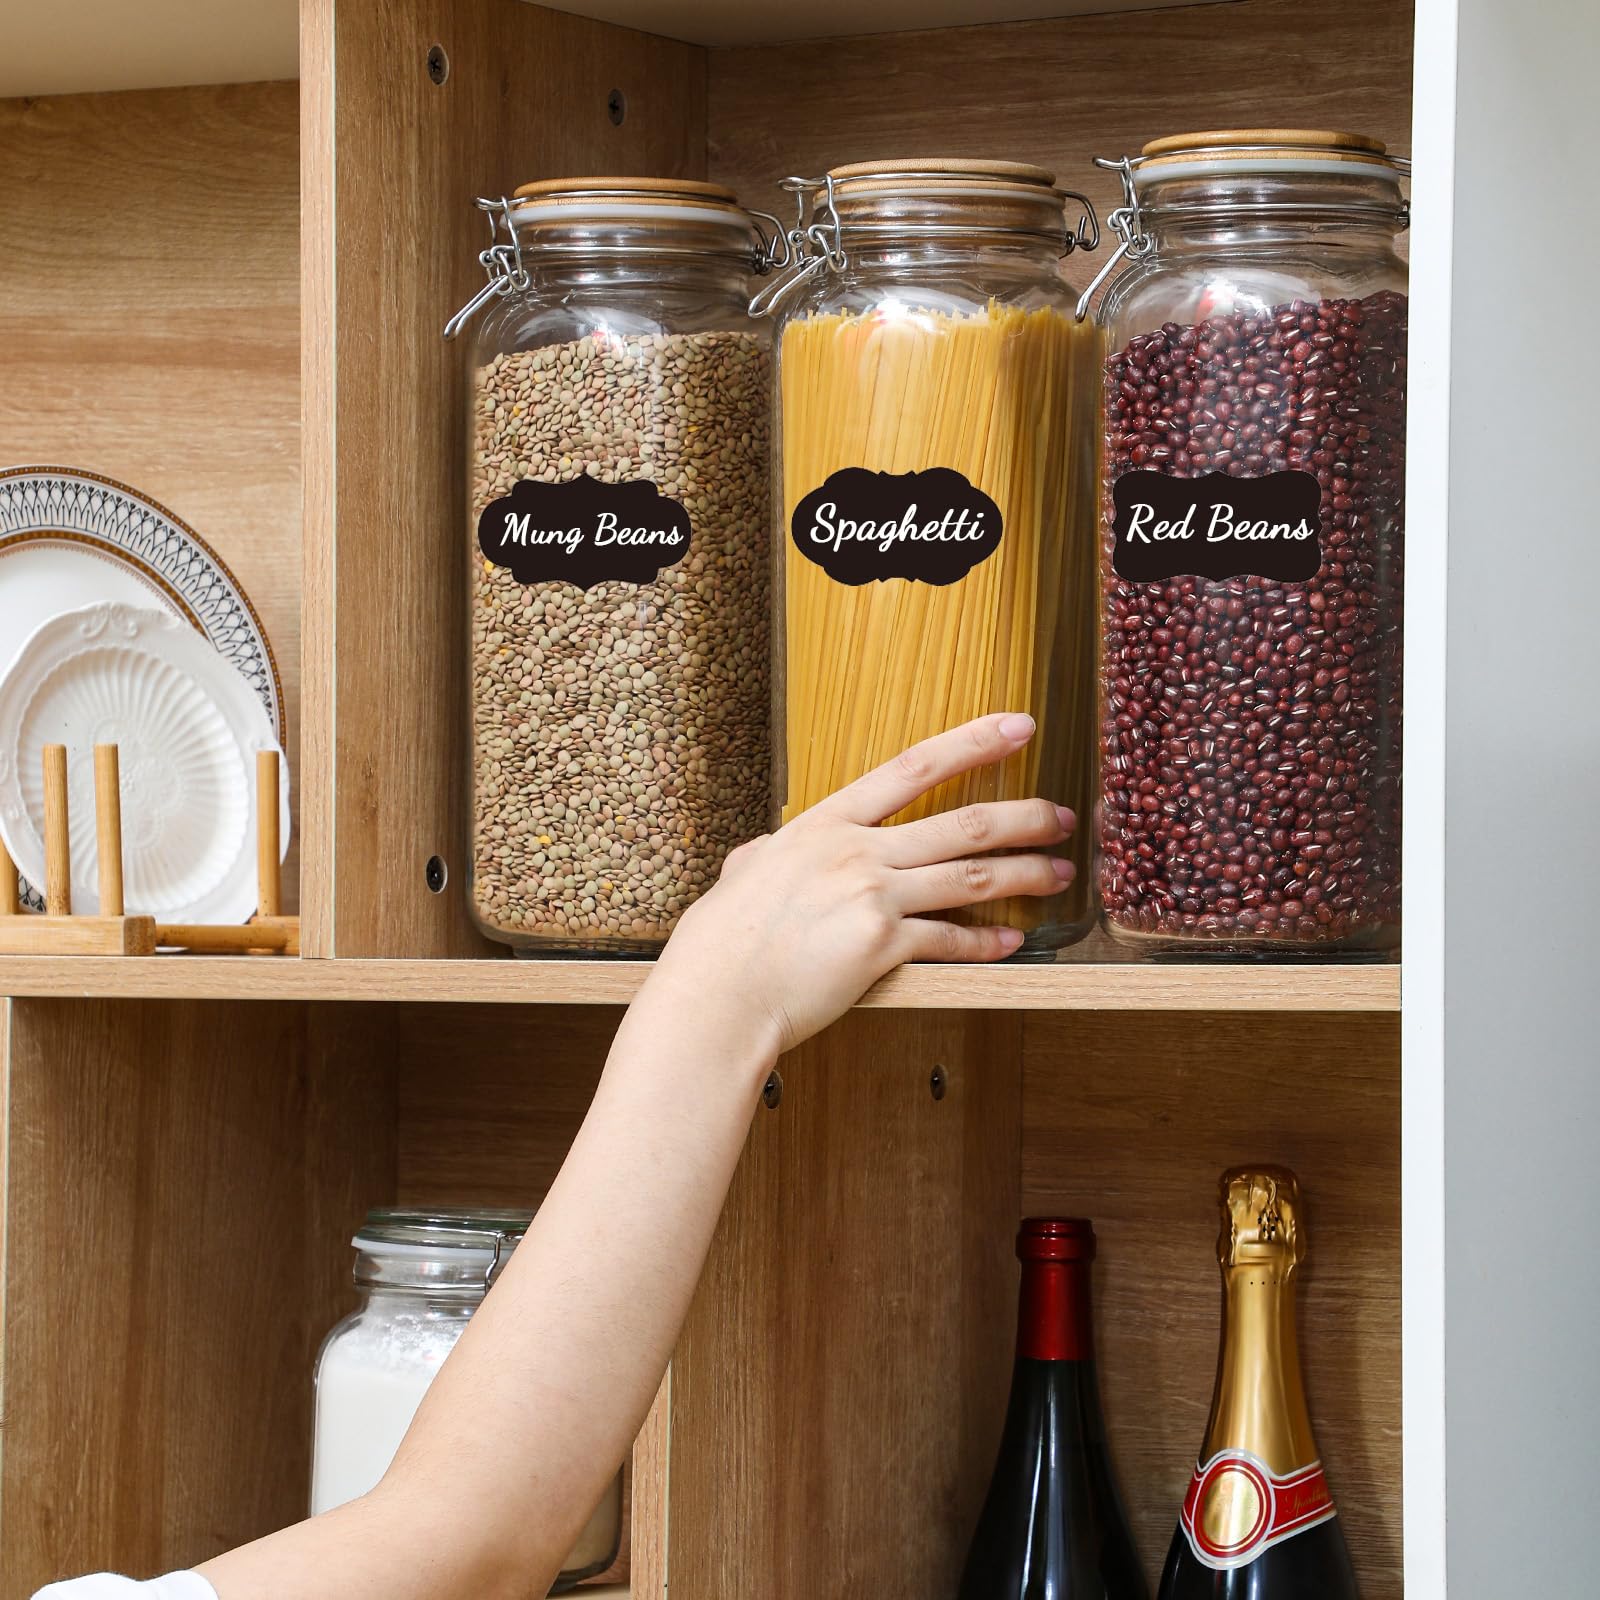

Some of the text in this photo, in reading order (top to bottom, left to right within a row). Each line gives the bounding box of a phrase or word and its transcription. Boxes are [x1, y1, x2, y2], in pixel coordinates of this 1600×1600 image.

[500, 512, 685, 555] Mung Beans
[809, 502, 985, 553] Spaghetti
[1126, 503, 1314, 543] Red Beans
